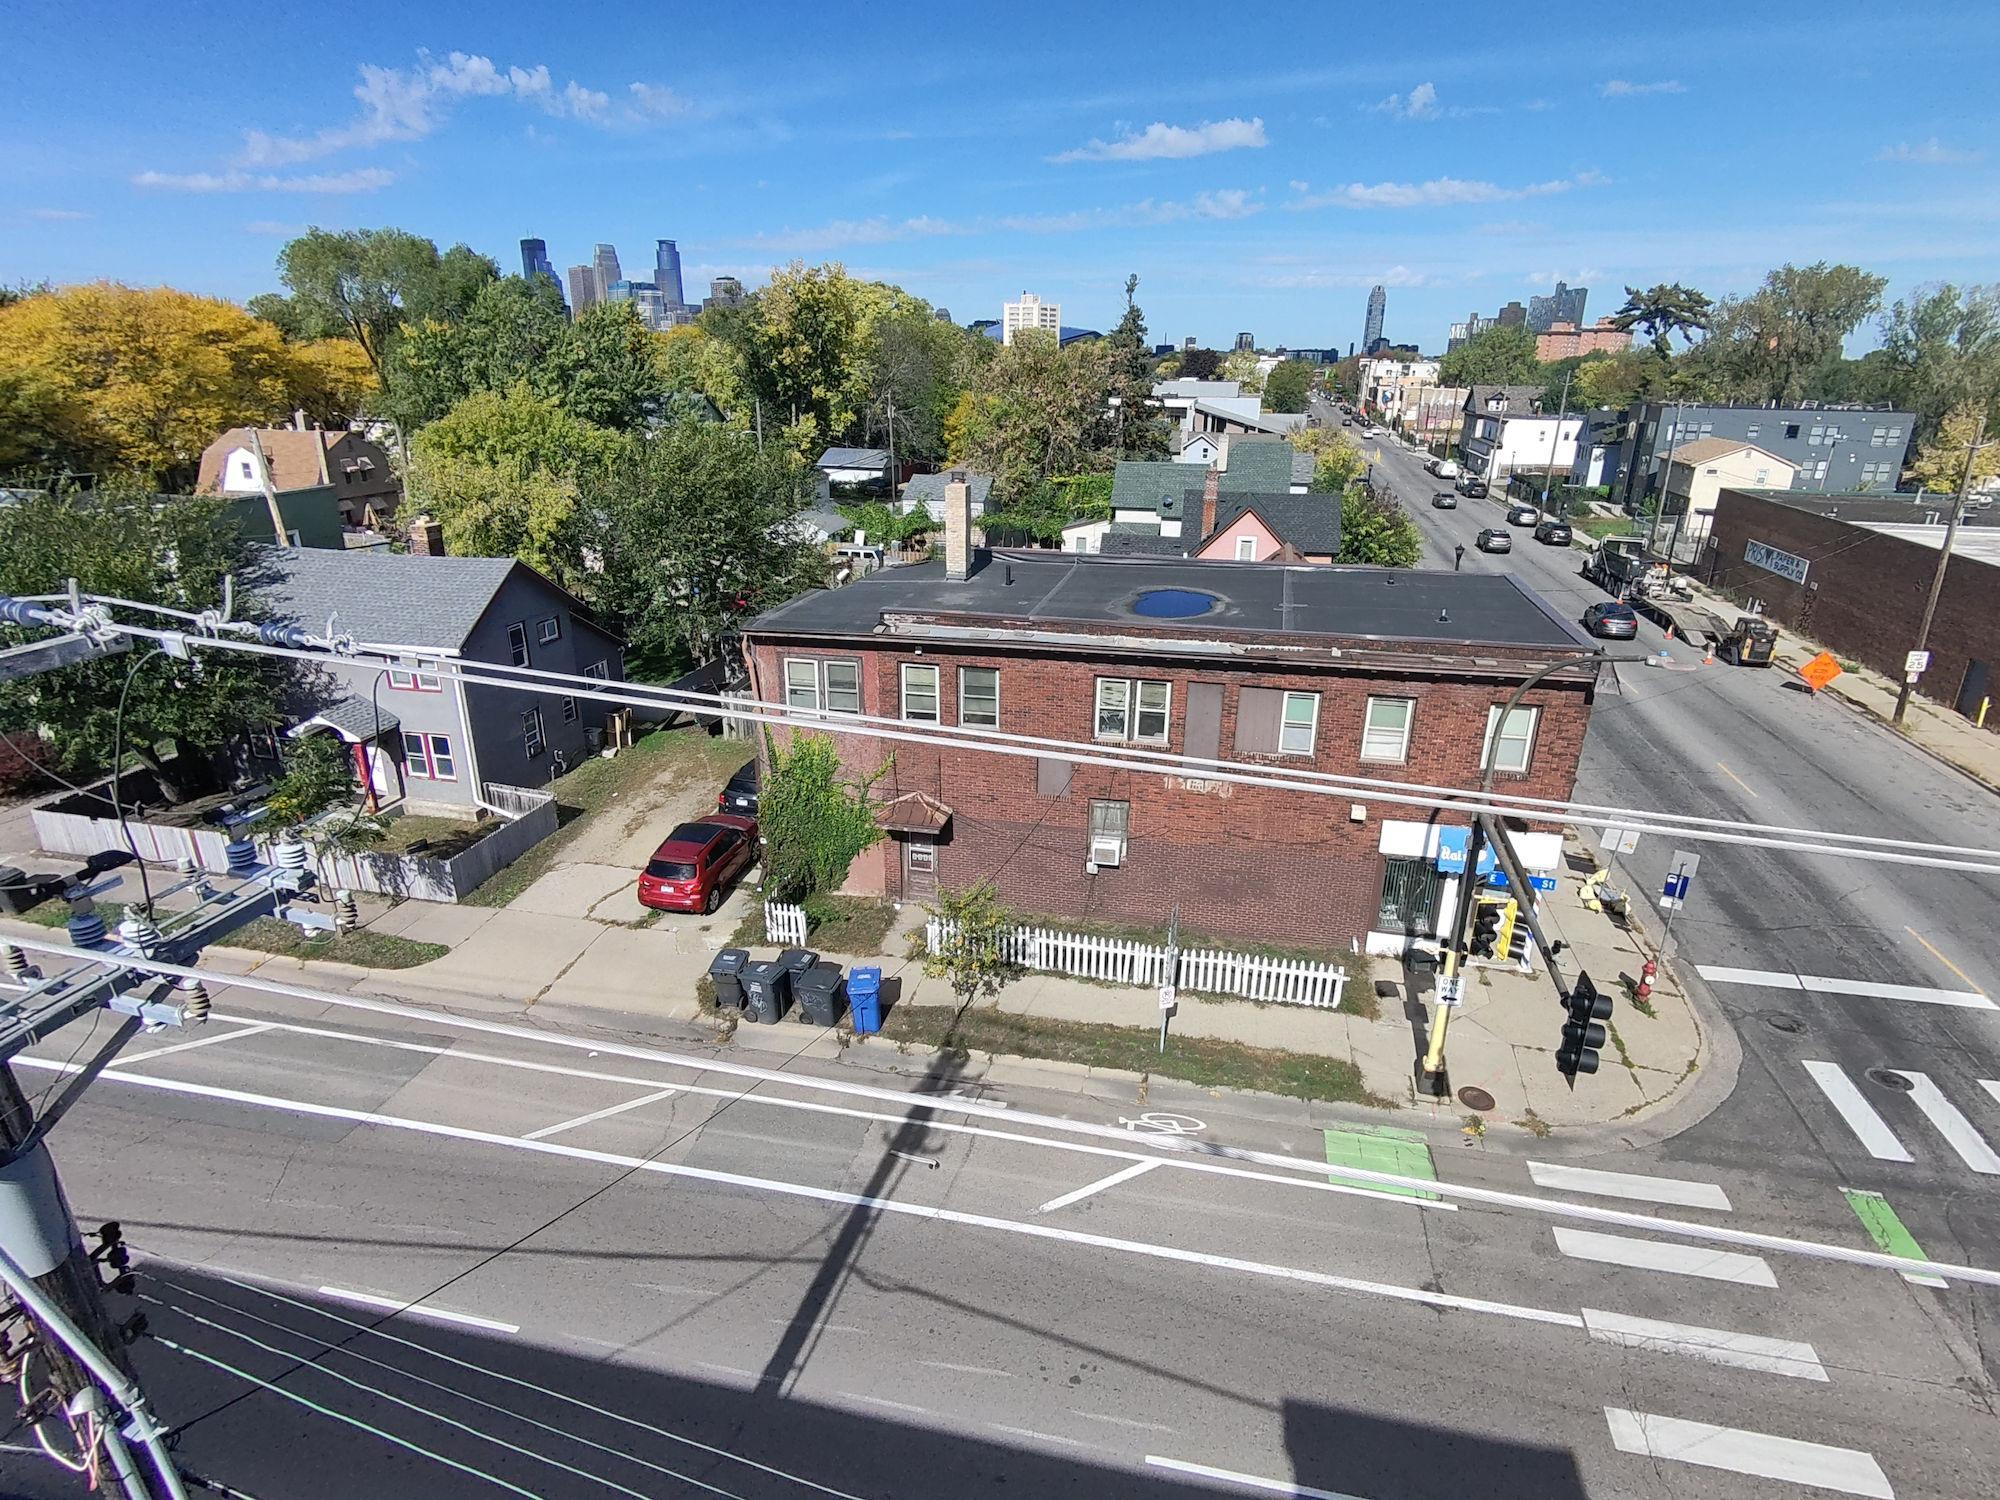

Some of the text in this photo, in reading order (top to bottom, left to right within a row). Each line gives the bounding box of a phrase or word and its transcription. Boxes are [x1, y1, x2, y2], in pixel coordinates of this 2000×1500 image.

[1907, 661, 1924, 669] 25
[1541, 879, 1554, 889] St
[1442, 978, 1459, 987] ONE
[1441, 986, 1459, 995] WAY
